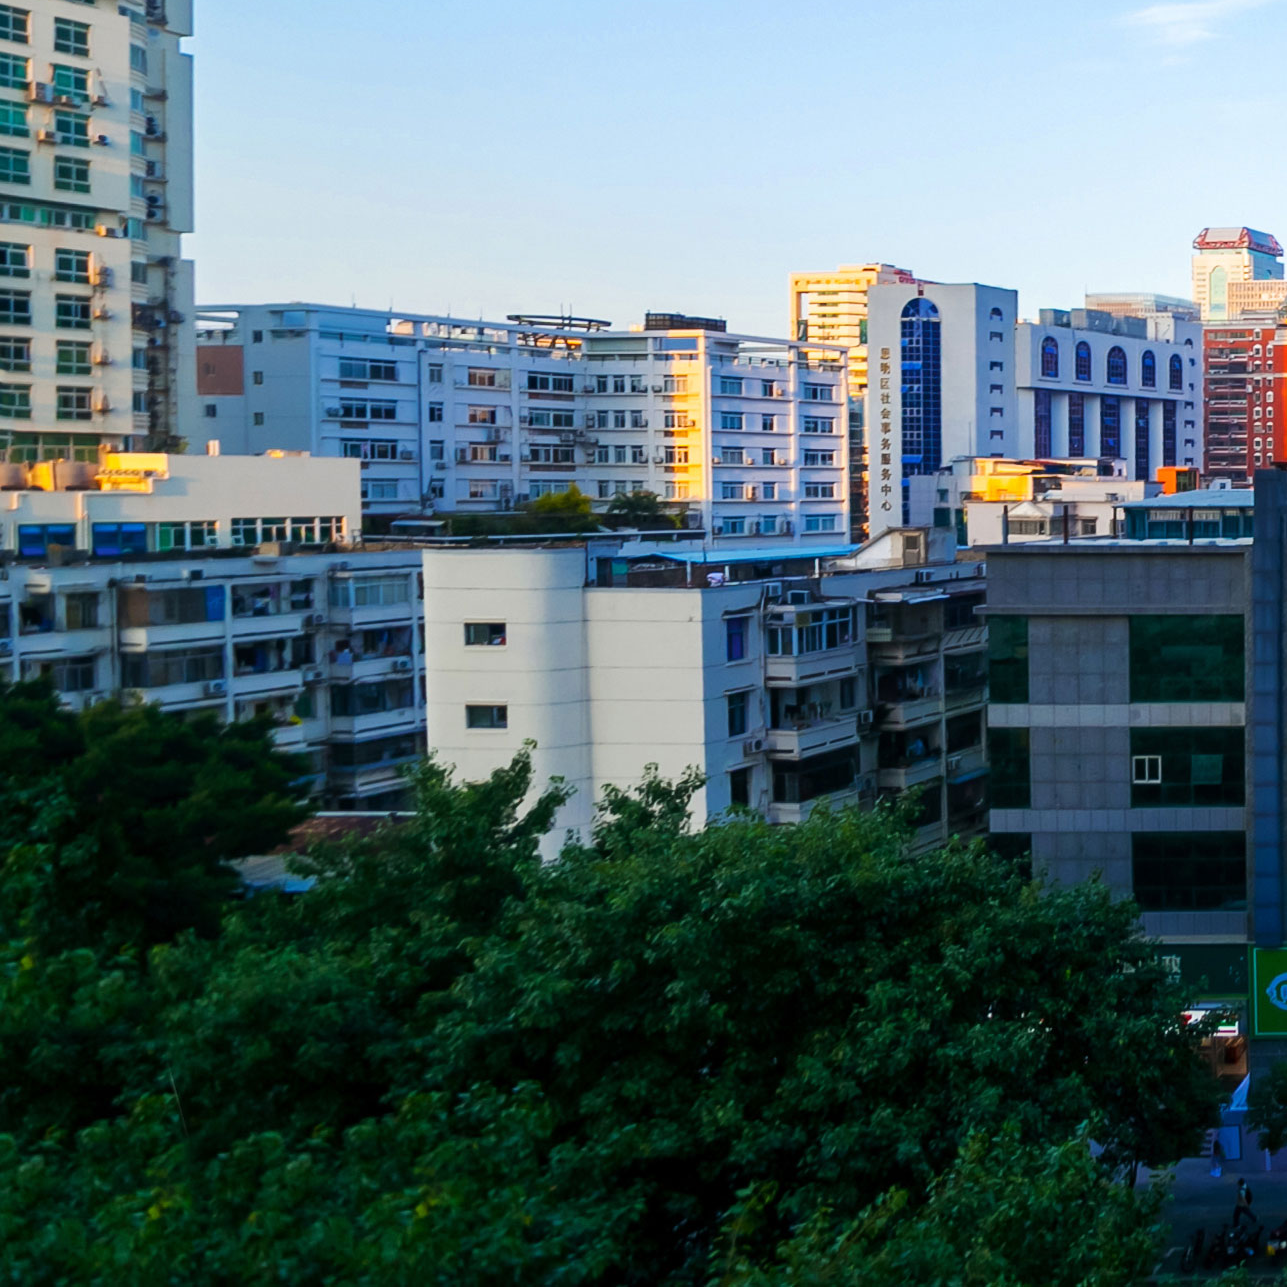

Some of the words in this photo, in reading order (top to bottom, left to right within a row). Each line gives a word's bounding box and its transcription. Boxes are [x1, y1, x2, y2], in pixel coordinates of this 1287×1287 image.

[881, 348, 892, 511] 思明区社会事务服务中心
